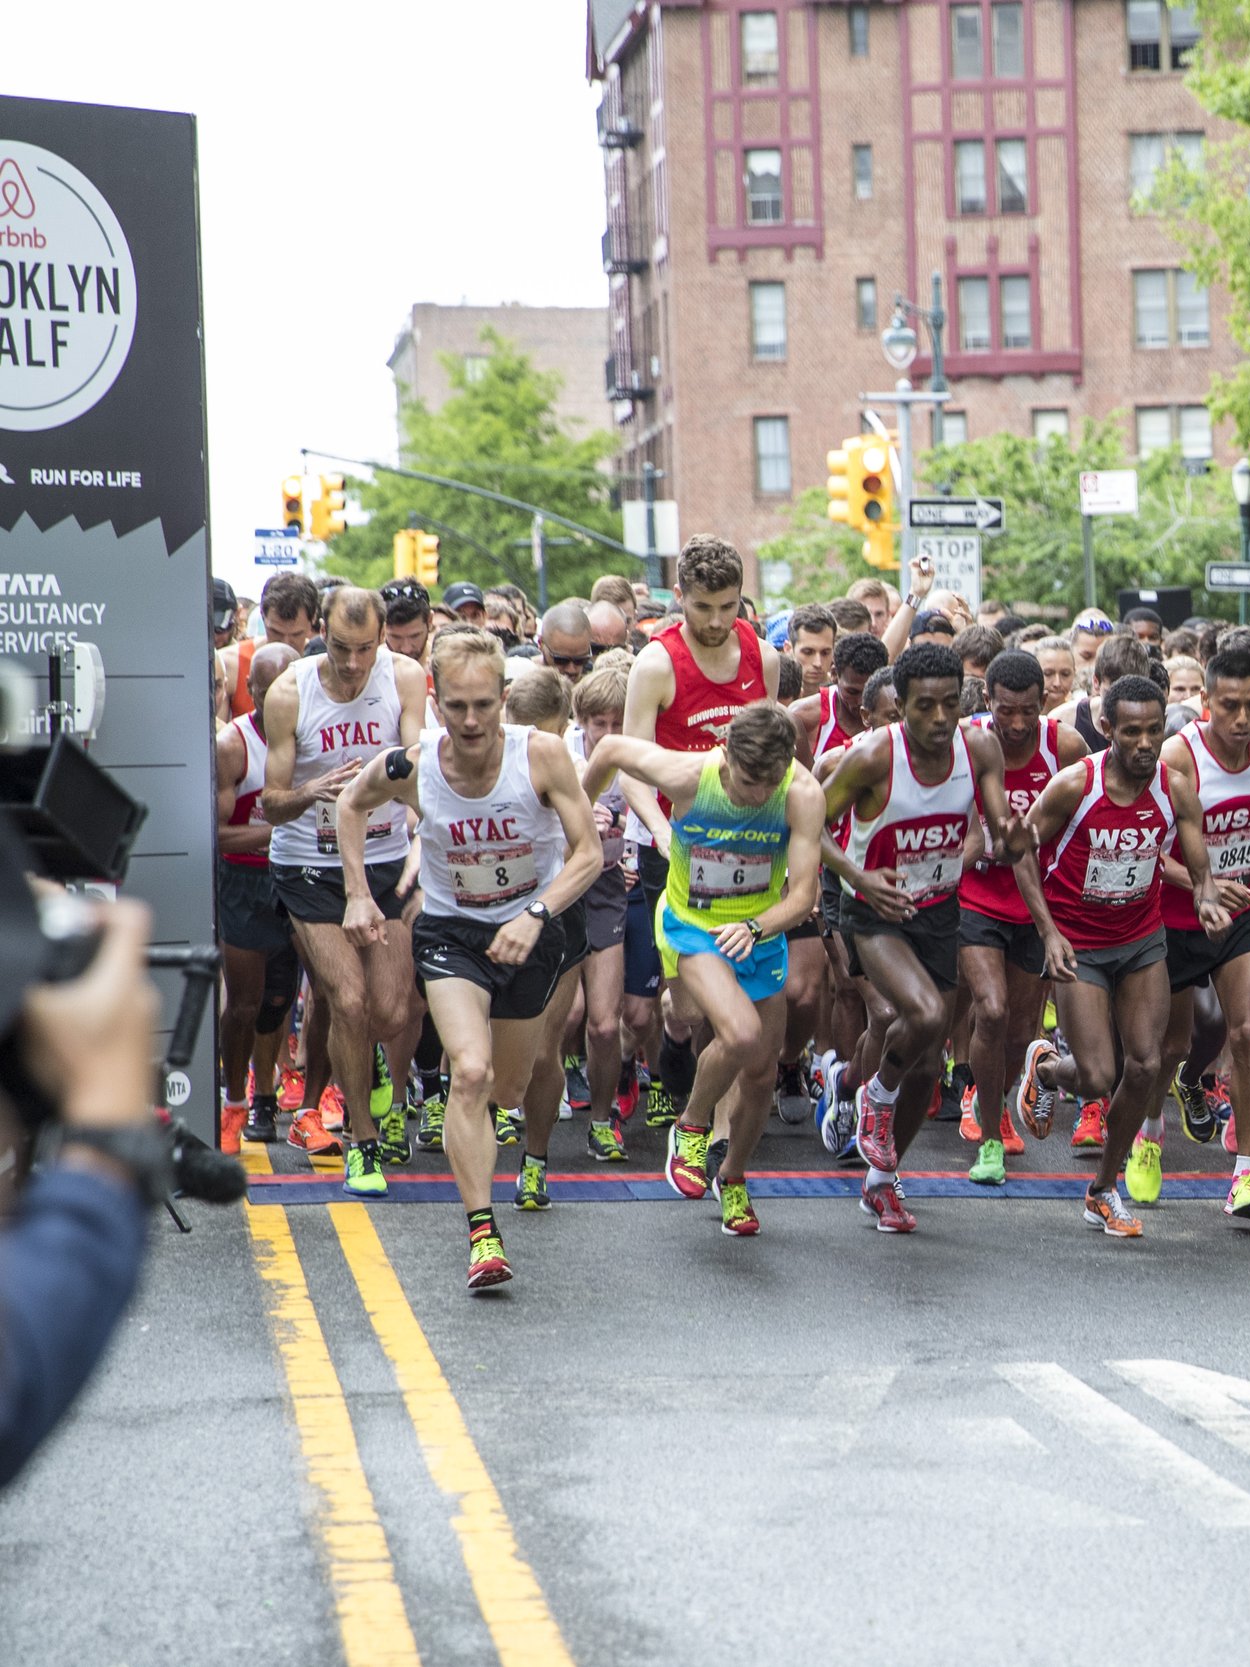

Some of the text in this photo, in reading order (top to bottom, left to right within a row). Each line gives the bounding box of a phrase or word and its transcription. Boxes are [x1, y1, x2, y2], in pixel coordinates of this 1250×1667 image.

[31, 468, 66, 485] RUN
[70, 470, 104, 486] FOR
[107, 471, 142, 488] LIFE
[921, 541, 975, 558] STOP
[320, 721, 381, 752] NYAC
[449, 817, 519, 846] NYAC
[706, 827, 781, 843] BROOKS
[895, 821, 964, 851] WSX
[1089, 827, 1161, 851] WSX
[495, 867, 509, 886] 8
[733, 869, 745, 885] 6
[932, 863, 943, 882] 4
[1125, 866, 1136, 887] 5
